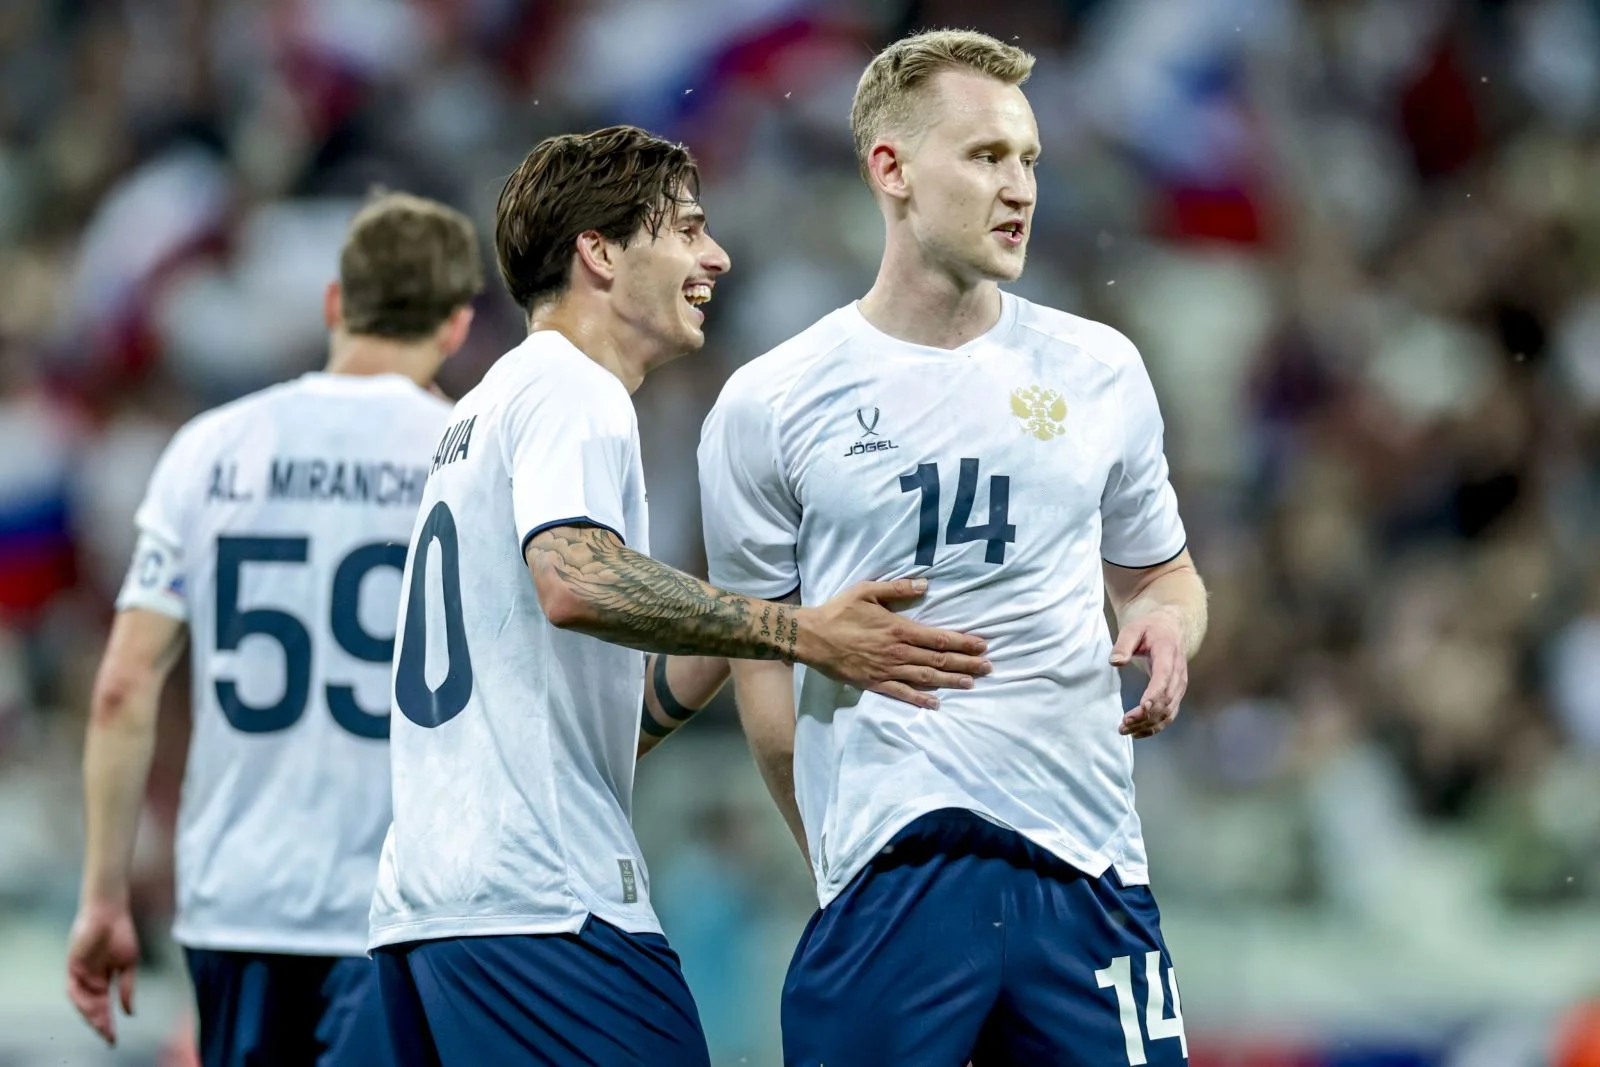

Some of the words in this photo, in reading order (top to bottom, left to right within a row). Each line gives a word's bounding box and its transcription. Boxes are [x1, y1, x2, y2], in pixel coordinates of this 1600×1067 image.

[206, 459, 253, 503] AL.
[267, 456, 429, 506] MIRANCH
[430, 414, 478, 476] ANIA
[843, 440, 899, 457] JÖGEL
[899, 457, 1016, 566] 14
[212, 535, 408, 740] 59
[395, 500, 473, 728] 0
[1094, 950, 1188, 1067] 14
